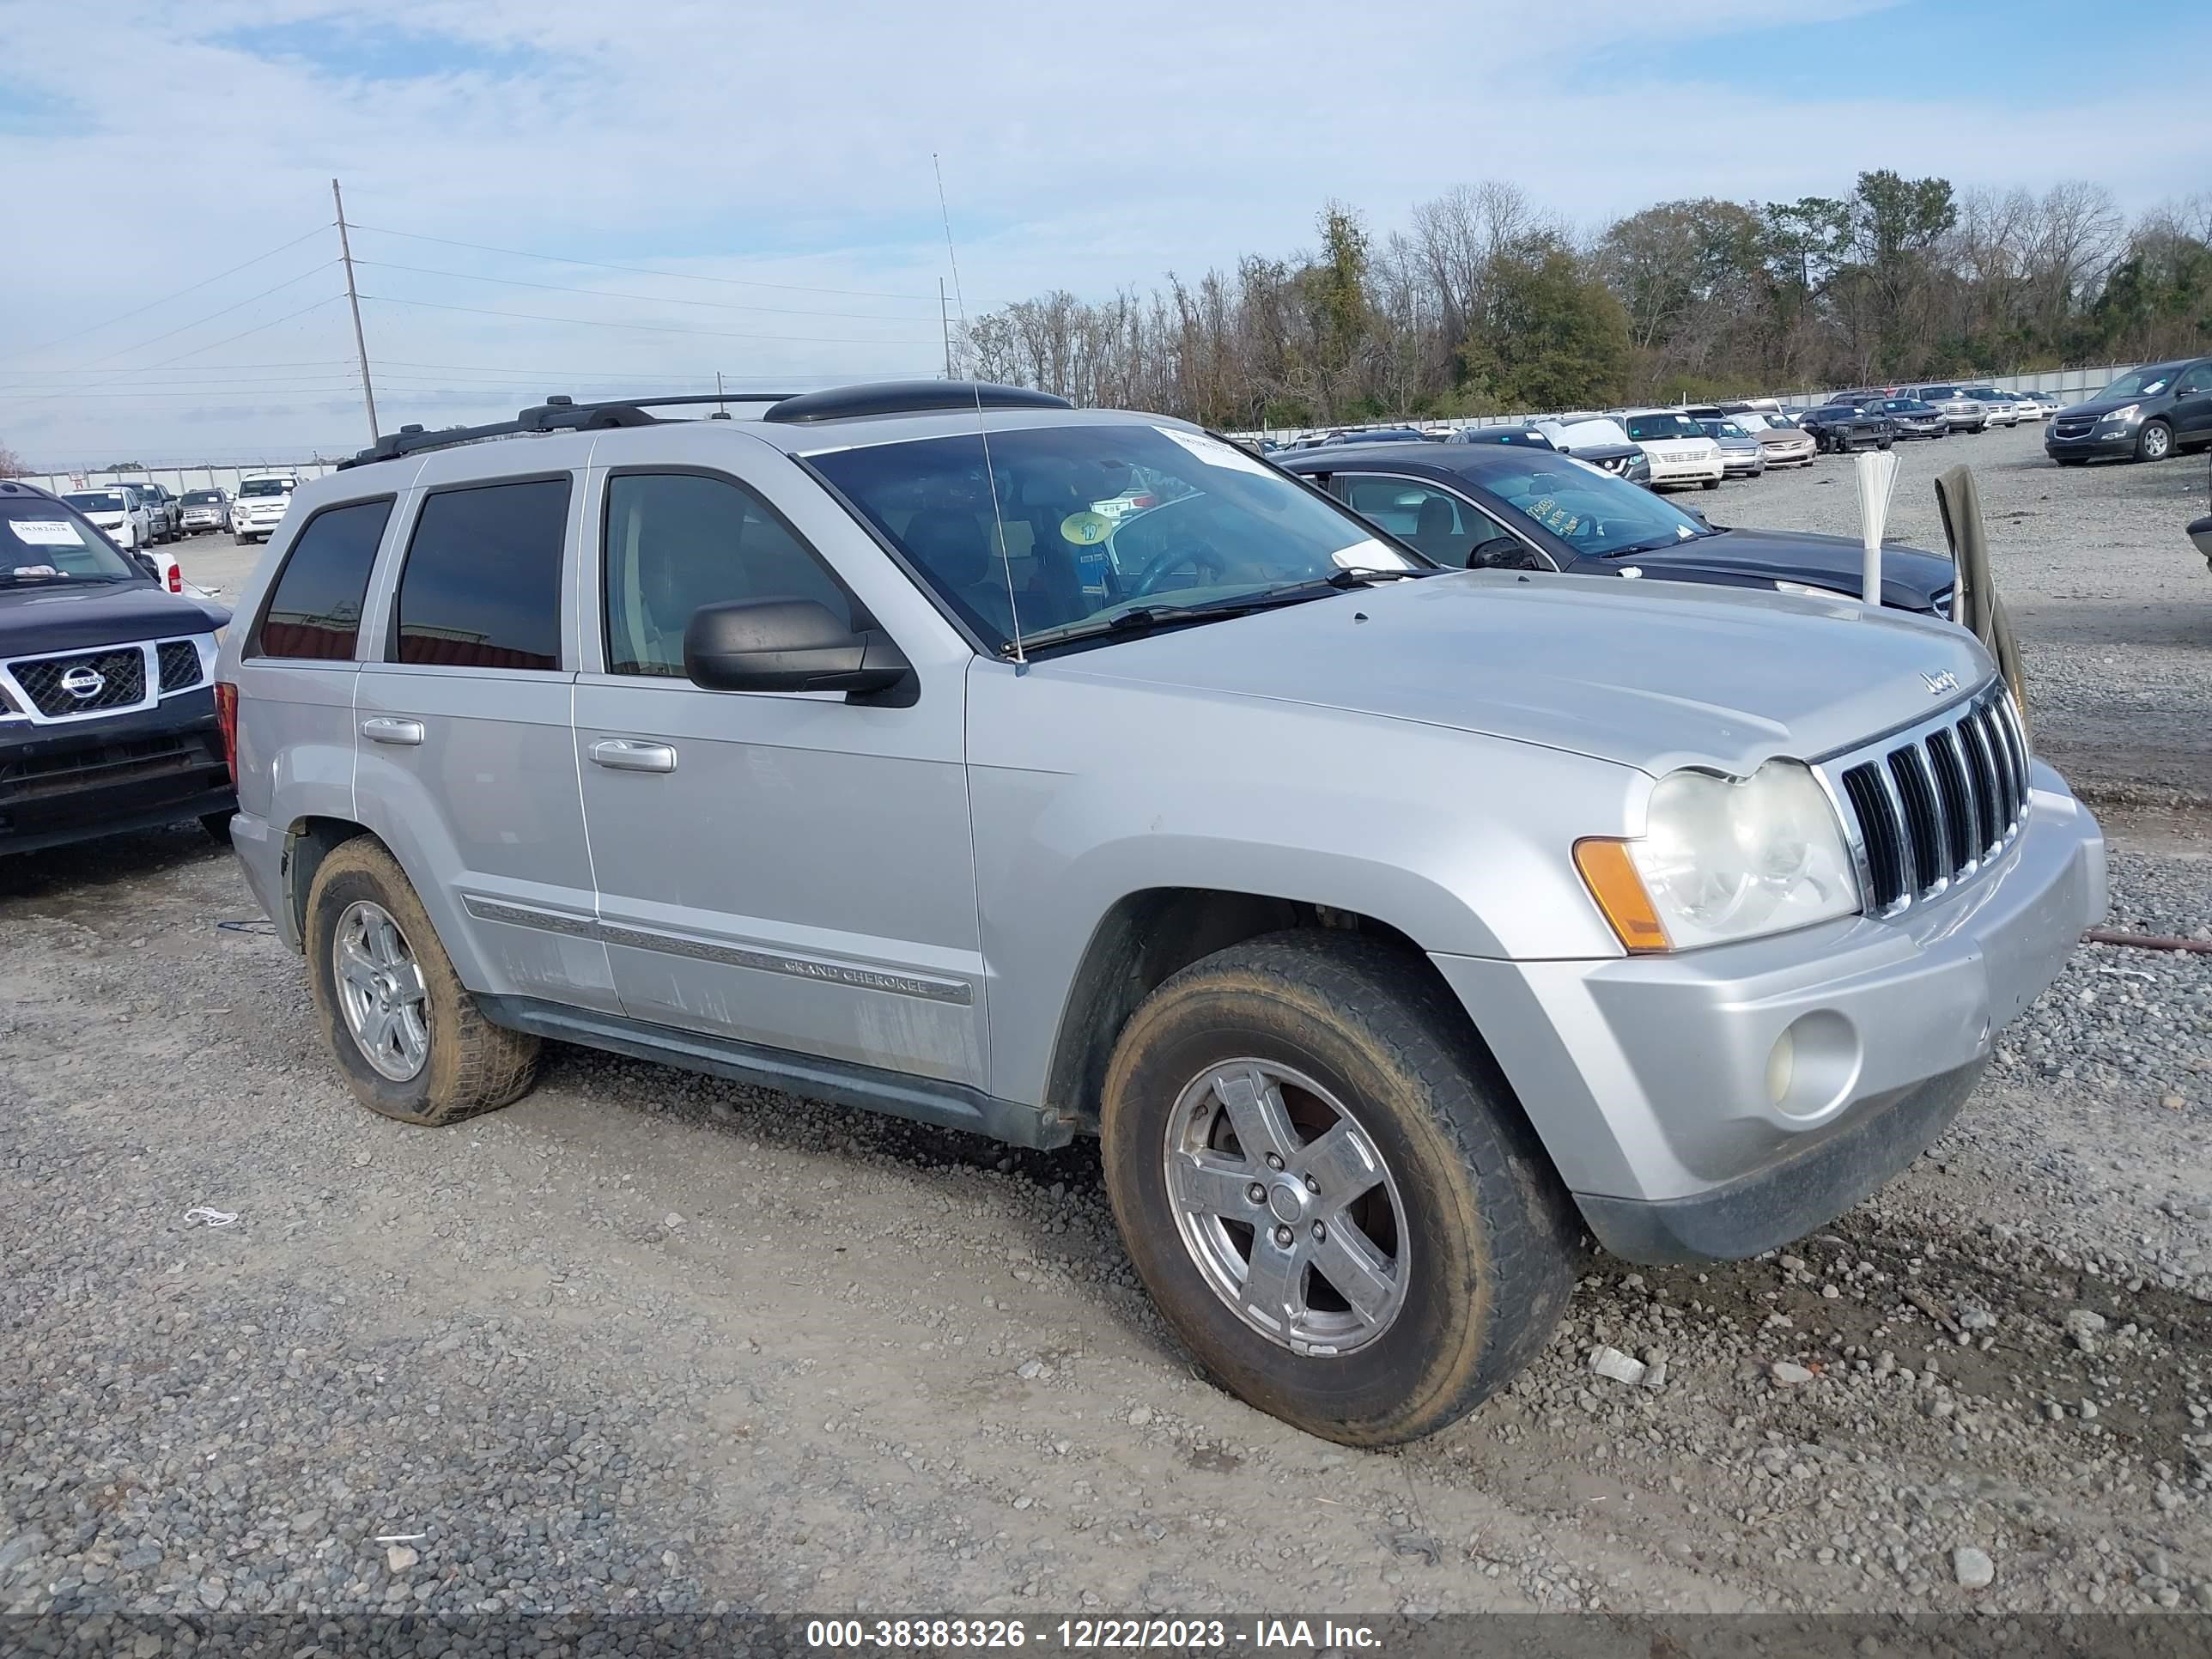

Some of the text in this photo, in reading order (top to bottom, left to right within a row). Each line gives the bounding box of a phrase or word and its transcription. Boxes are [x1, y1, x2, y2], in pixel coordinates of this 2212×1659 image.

[68, 675, 104, 686] NISSAN
[1918, 669, 1960, 695] Jeep
[784, 960, 928, 994] GRAND CHEROKEE
